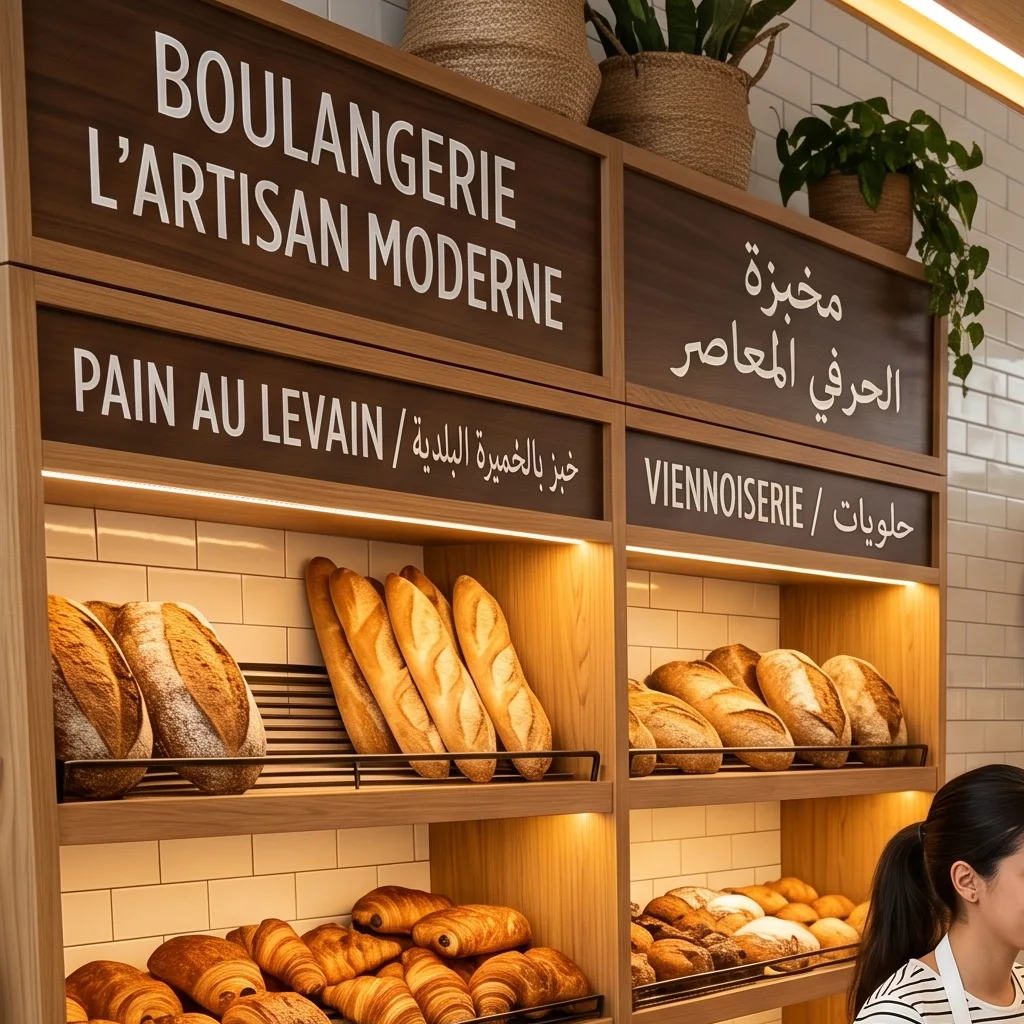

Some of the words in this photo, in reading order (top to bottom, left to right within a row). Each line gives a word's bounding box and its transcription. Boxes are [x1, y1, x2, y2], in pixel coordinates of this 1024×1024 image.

[154, 30, 517, 230] BOULANGERIE
[88, 126, 350, 273] L’ARTISAN
[368, 212, 564, 331] MODERNE
[744, 241, 843, 325] مخبزة
[73, 347, 176, 427] PAIN
[669, 319, 796, 389] المعاصر
[809, 347, 901, 424] الحرفي
[193, 372, 245, 437] AU
[261, 384, 383, 460] LEVAIN
[412, 415, 470, 479] البلدية
[475, 429, 544, 492] بالخميرة
[548, 450, 579, 495] خبز
[644, 457, 804, 529] VIENNOISERIE
[832, 497, 914, 549] حلويات
